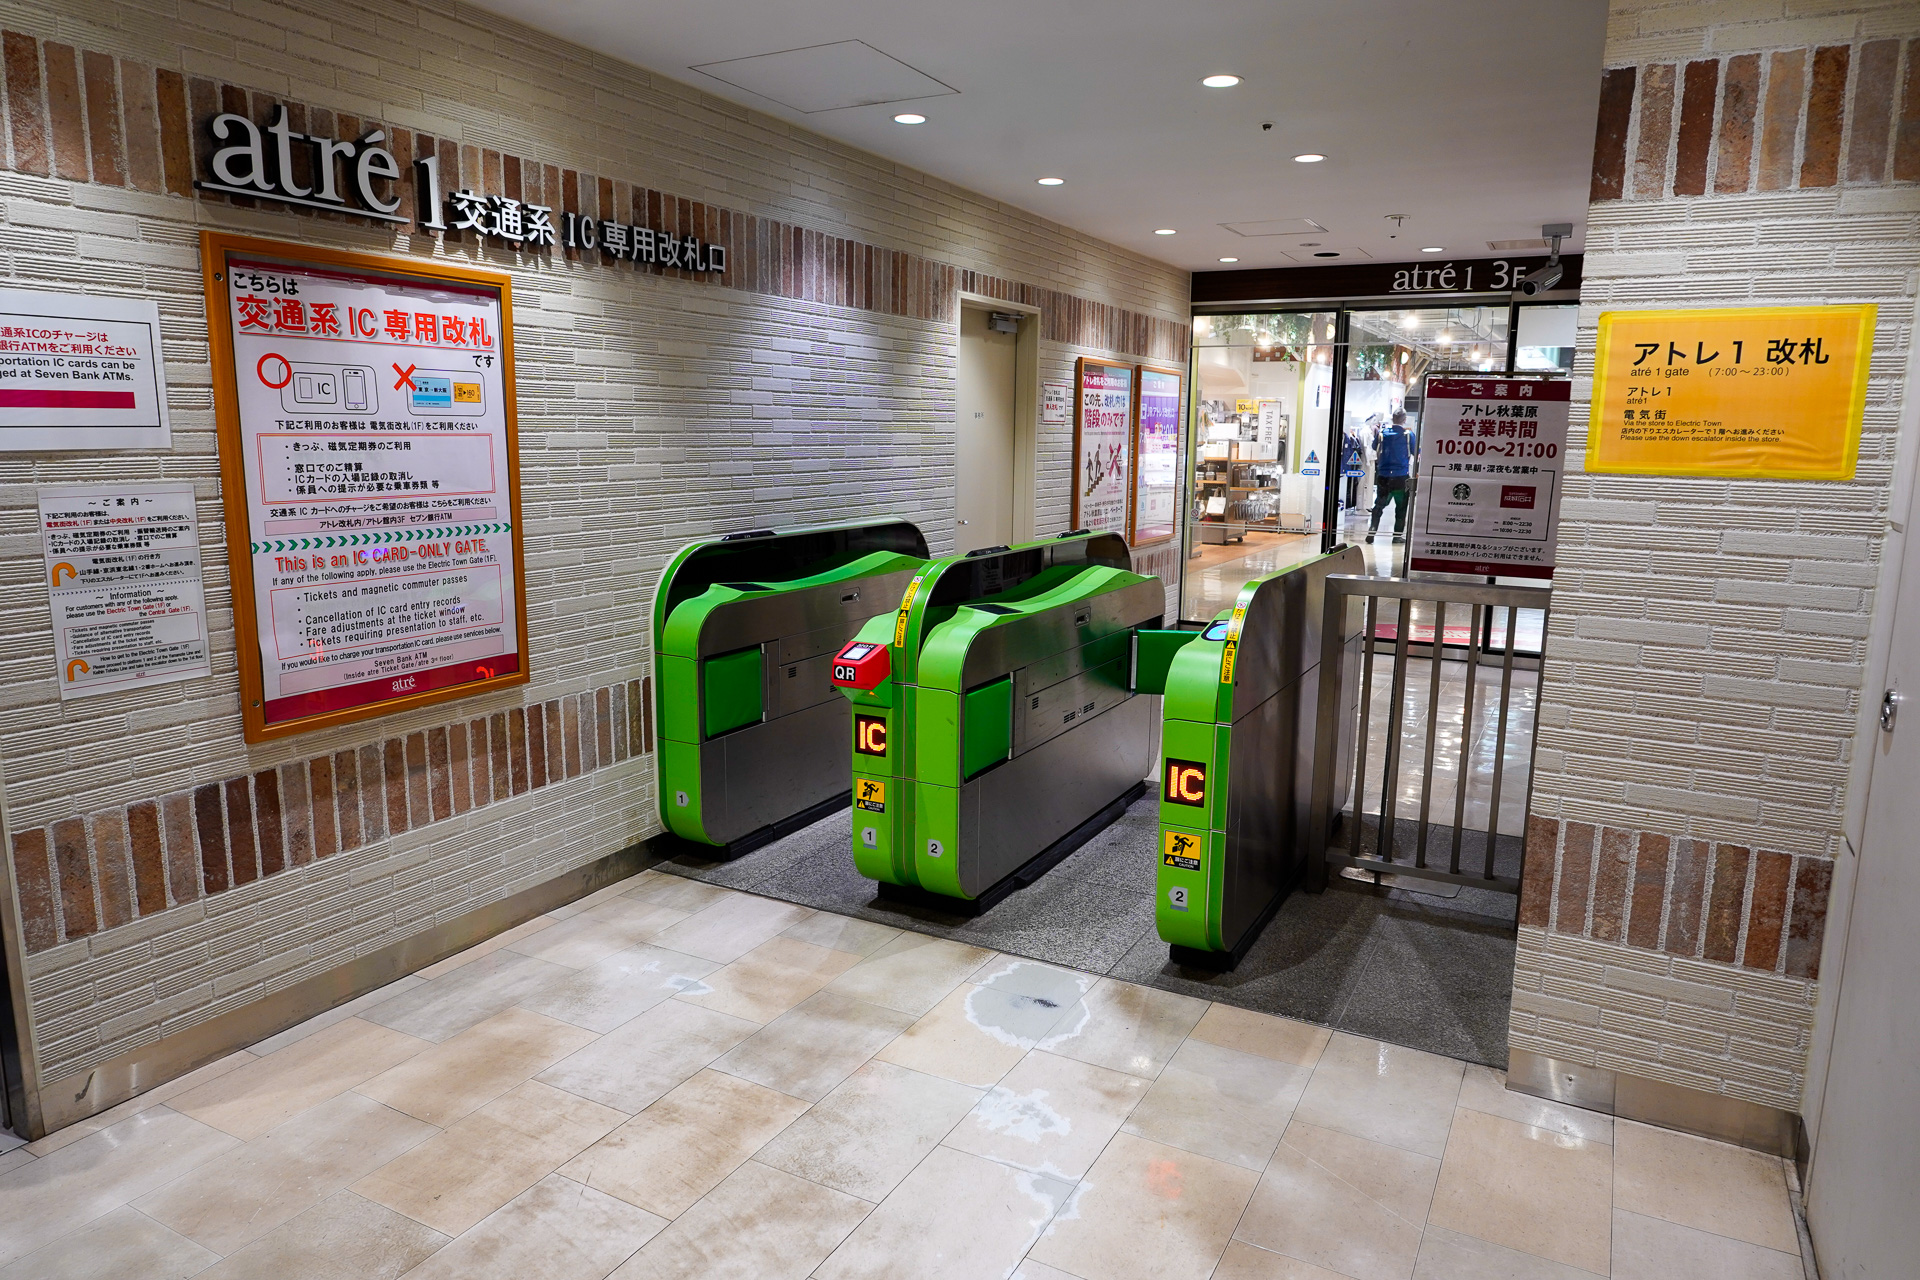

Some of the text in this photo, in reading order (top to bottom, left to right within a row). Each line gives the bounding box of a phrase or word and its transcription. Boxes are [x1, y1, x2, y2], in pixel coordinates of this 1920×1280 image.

[212, 105, 726, 272] atré 1 交通系 IC 専用改札口
[1392, 261, 1526, 291] atré 1 3F
[234, 273, 299, 296] こちらは
[237, 296, 494, 346] 交通系 IC 専用改札
[0, 327, 108, 342] 通系ICのチャージは
[53, 358, 65, 367] IC
[68, 359, 98, 369] cards
[122, 360, 135, 370] be
[472, 354, 495, 368] です
[20, 369, 32, 378] at
[34, 369, 69, 379] Seven
[72, 370, 100, 380] Bank
[102, 371, 134, 381] ATMs.
[1630, 367, 1652, 377] atré
[1656, 367, 1661, 376] 1
[1664, 367, 1690, 379] gate
[317, 382, 331, 395] IC
[1265, 410, 1273, 424] TAX
[1462, 404, 1538, 418] アトレ秋葉原
[1624, 409, 1667, 422] 電気街
[1084, 409, 1125, 428] 階段のみです
[1459, 419, 1538, 439] 営業時間
[1747, 436, 1760, 444] the
[102, 498, 139, 507] ご案内
[274, 540, 489, 573] This is an IC CARD-ONLY GATE.
[272, 577, 278, 586] If
[280, 577, 294, 586] any
[296, 574, 305, 584] of
[306, 574, 319, 582] the
[321, 571, 355, 581] following
[378, 566, 401, 576] please
[416, 562, 427, 571] the
[428, 560, 451, 569] Electric
[110, 590, 152, 600] Information
[303, 575, 468, 602] Tickets and magnetic commuter passes
[305, 596, 461, 625] Cancellation of IC card entry records
[306, 606, 466, 637] Fare adjustments at the ticket window
[307, 635, 341, 648] Tickets
[344, 629, 383, 642] requiring
[386, 621, 436, 637] presentation
[438, 619, 447, 628] to
[470, 613, 485, 622] etc.
[374, 651, 429, 668] Seven Bank ATM
[836, 666, 855, 680] QR
[392, 676, 415, 690] atré
[860, 721, 886, 752] IC
[1170, 765, 1204, 800] IC
[679, 794, 683, 803] 1
[867, 831, 873, 841] 1
[931, 843, 938, 854] 2
[1175, 890, 1184, 902] 2
